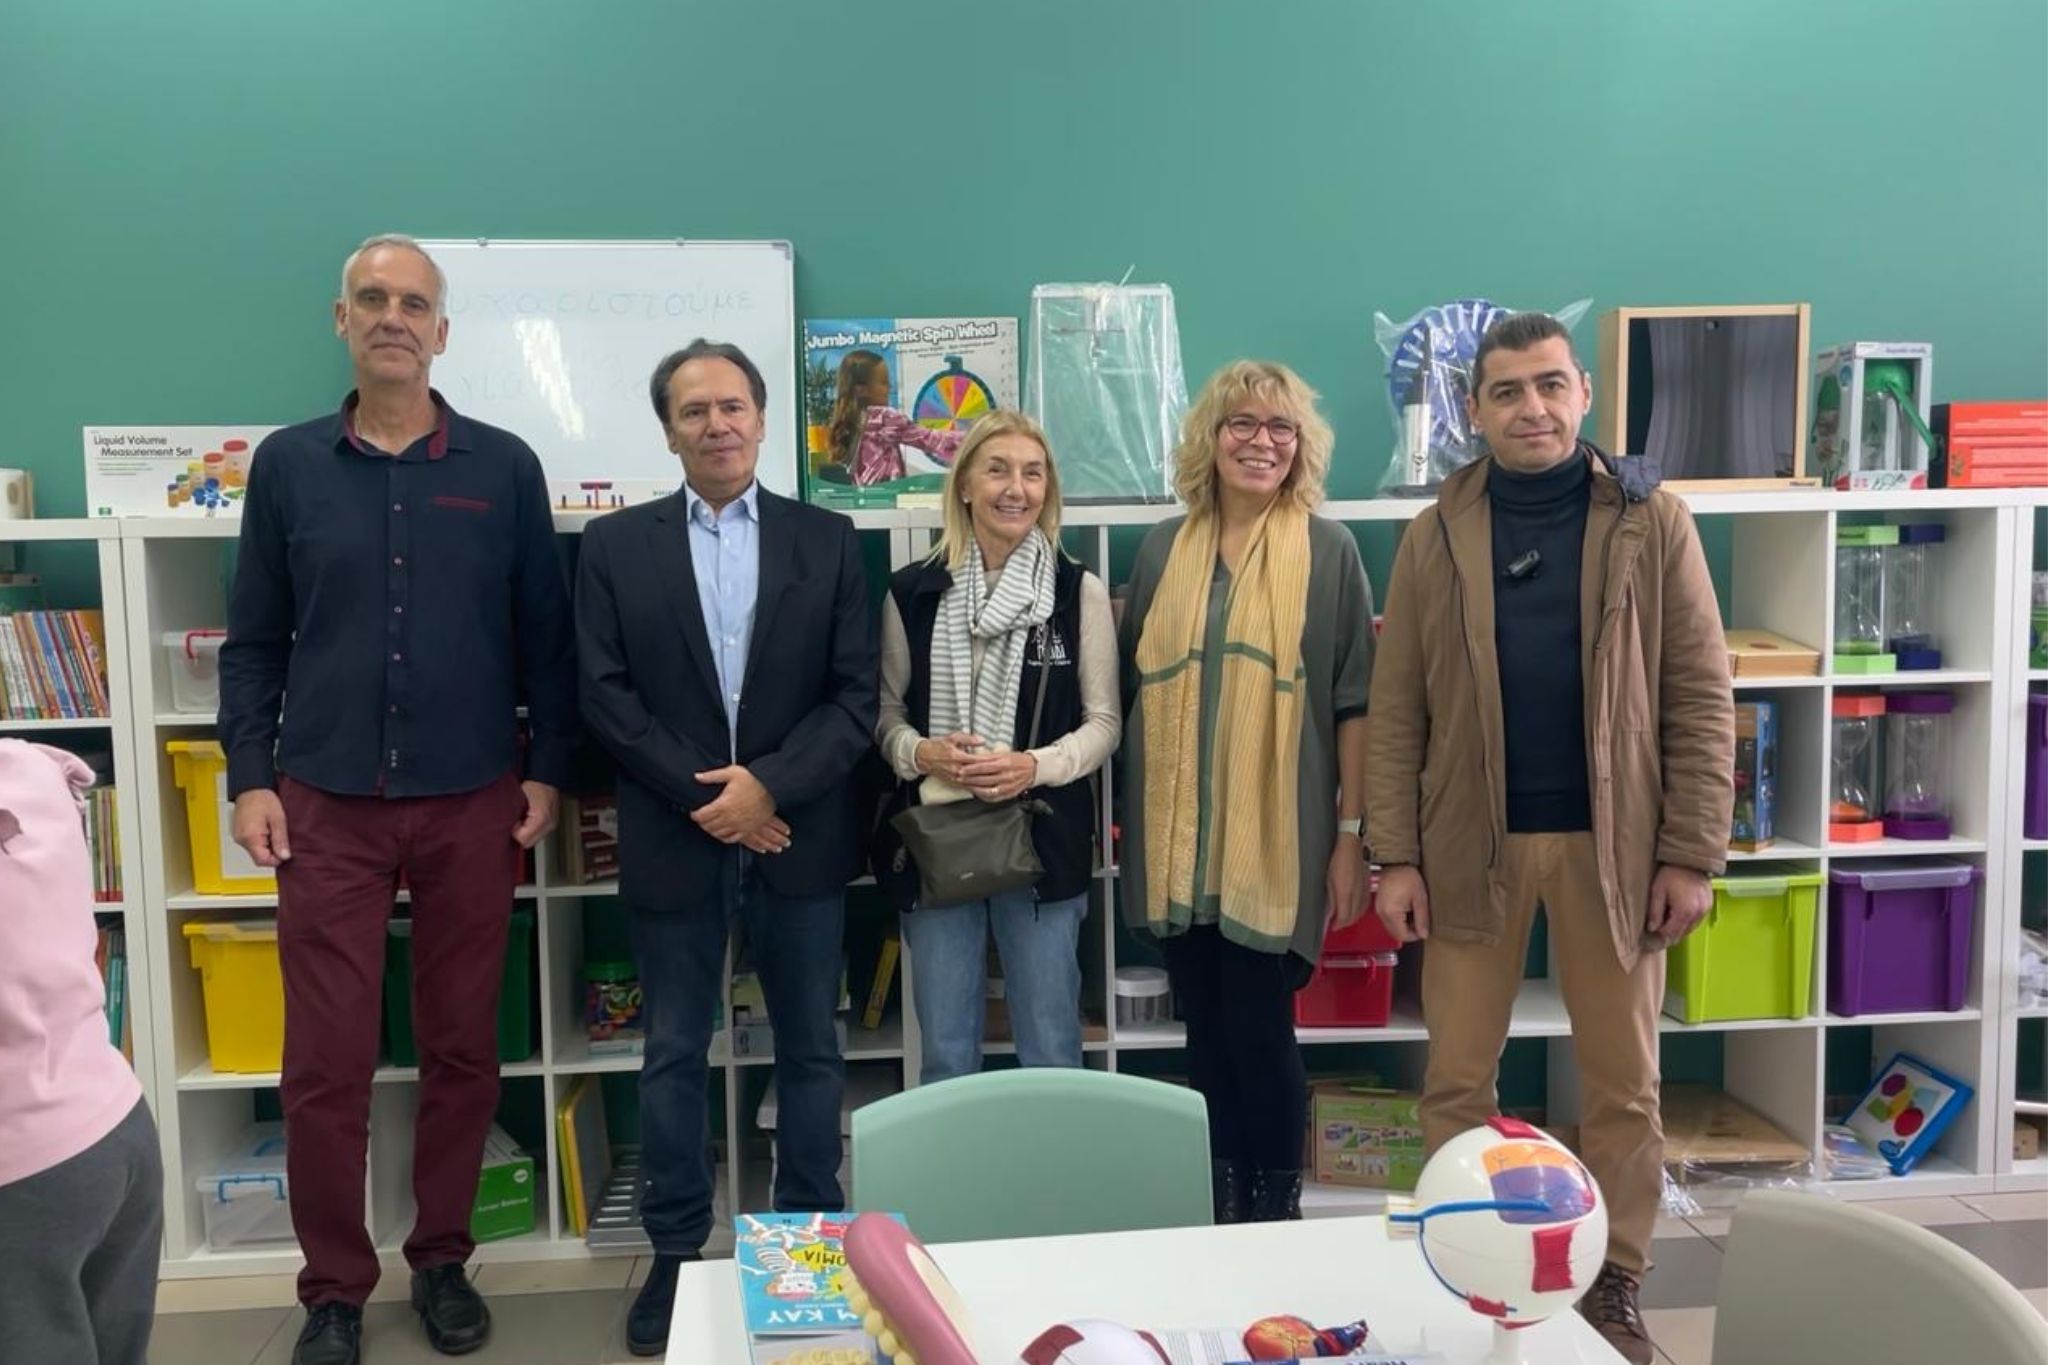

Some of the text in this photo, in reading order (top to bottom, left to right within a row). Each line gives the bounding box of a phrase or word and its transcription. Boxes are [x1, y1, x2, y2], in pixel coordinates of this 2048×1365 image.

[450, 282, 756, 325] υχαριστούμε
[807, 332, 855, 349] Jumbo
[859, 328, 919, 348] Magnetic
[922, 325, 954, 345] Spin
[957, 321, 998, 340] Wheel
[93, 435, 168, 446] Liquid Volume
[101, 447, 193, 457] Measurement Set
[803, 1250, 848, 1266] ΟΜΙΑ
[767, 1308, 825, 1324] KAY
